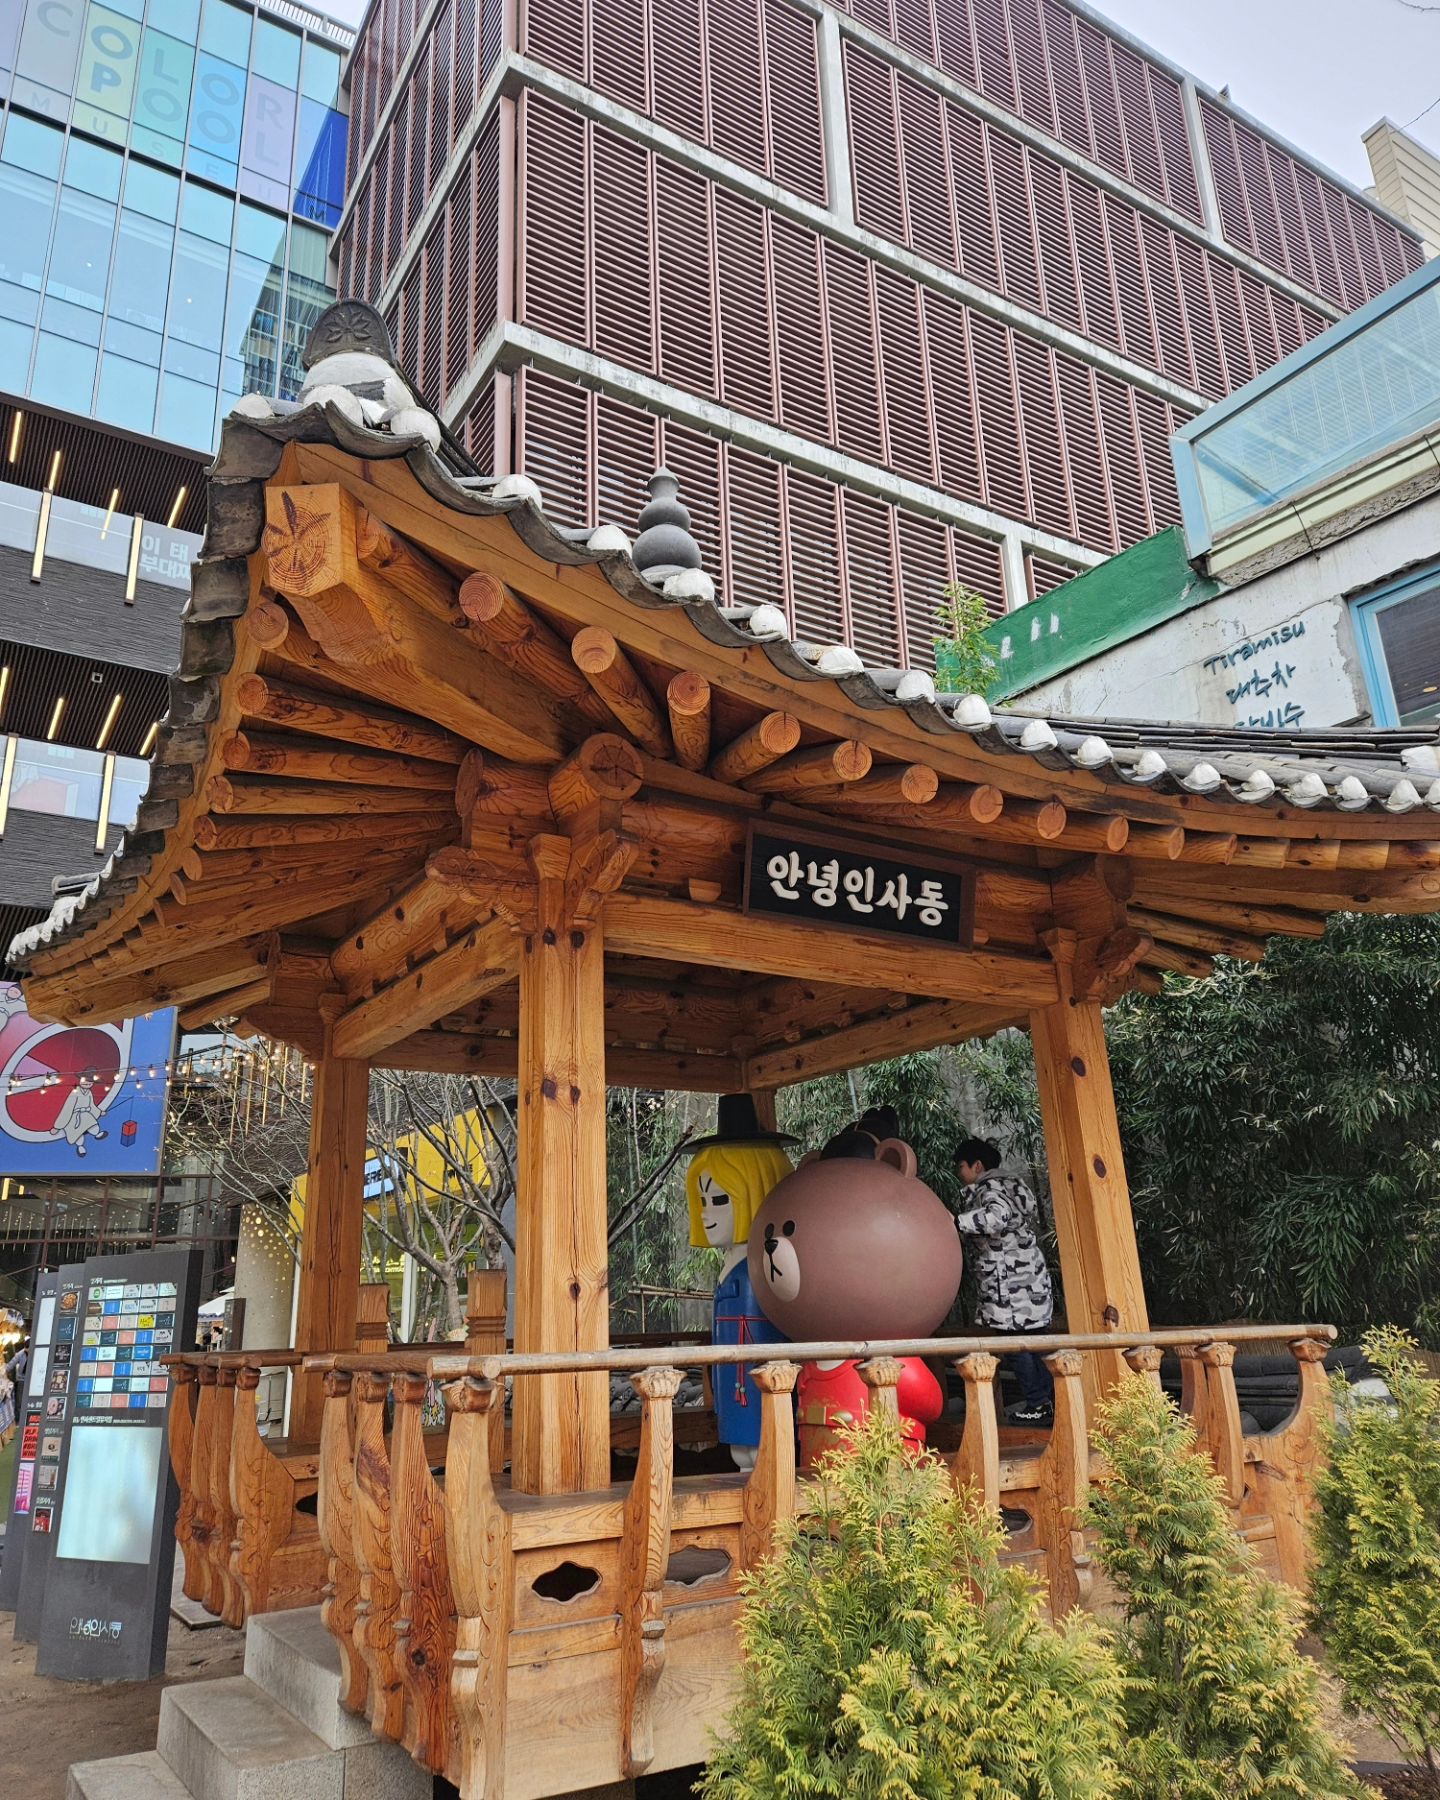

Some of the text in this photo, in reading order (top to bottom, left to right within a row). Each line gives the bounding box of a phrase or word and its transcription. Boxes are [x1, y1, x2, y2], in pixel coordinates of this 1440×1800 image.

[90, 62, 281, 166] POOL
[1203, 621, 1305, 675] Tiramisu
[1226, 661, 1296, 704] 대추차
[767, 851, 949, 926] 안녕인사동
